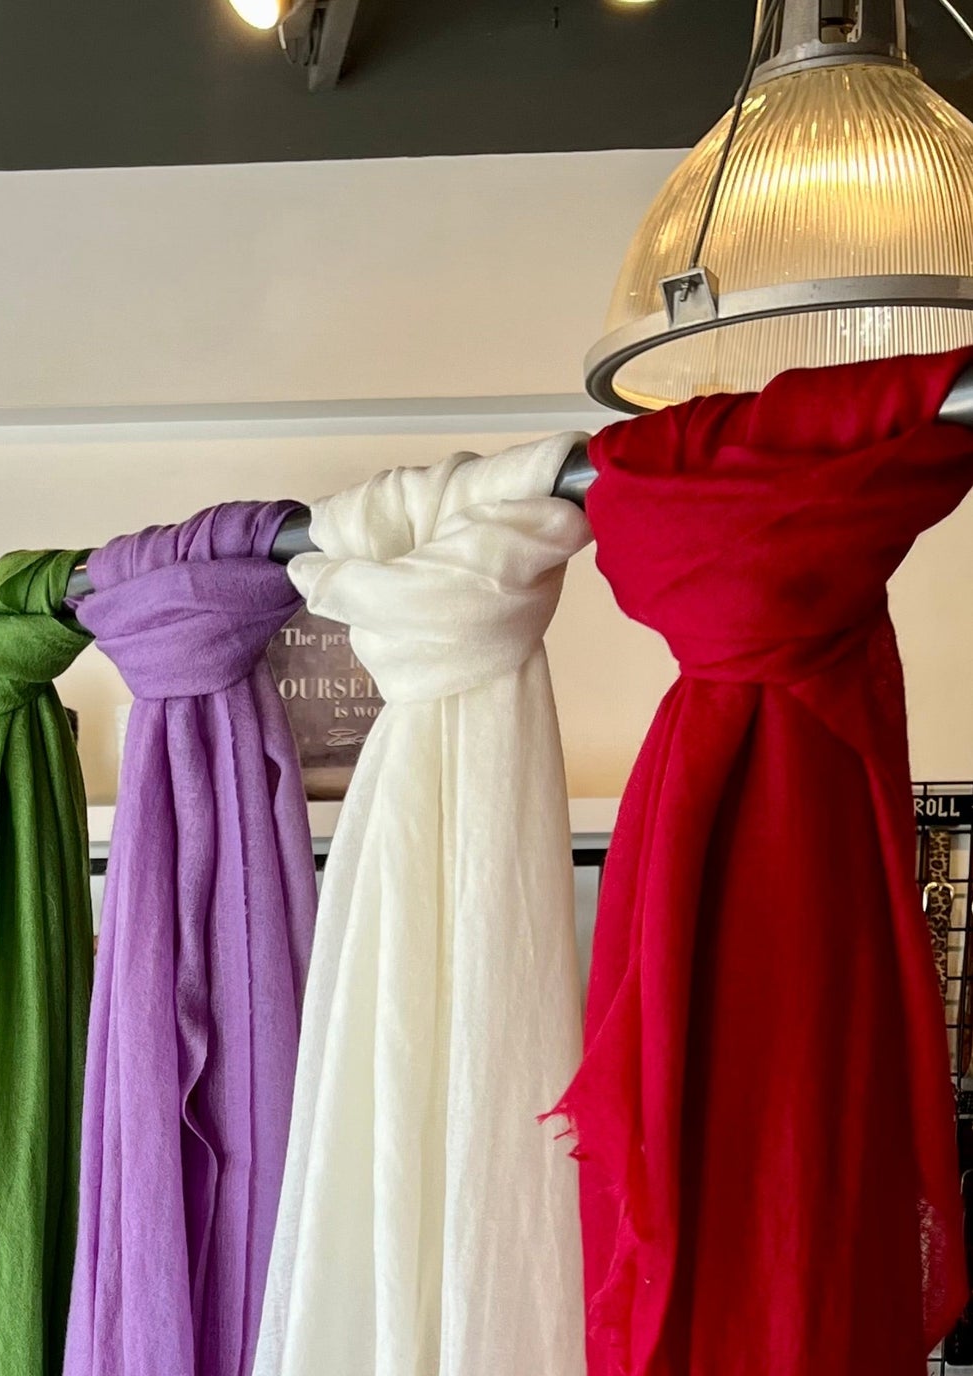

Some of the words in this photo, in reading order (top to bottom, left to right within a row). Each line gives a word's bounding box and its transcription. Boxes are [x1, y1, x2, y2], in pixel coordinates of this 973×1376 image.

[280, 628, 317, 647] The
[321, 627, 350, 652] pri
[334, 701, 349, 718] is
[914, 797, 961, 817] ROLL
